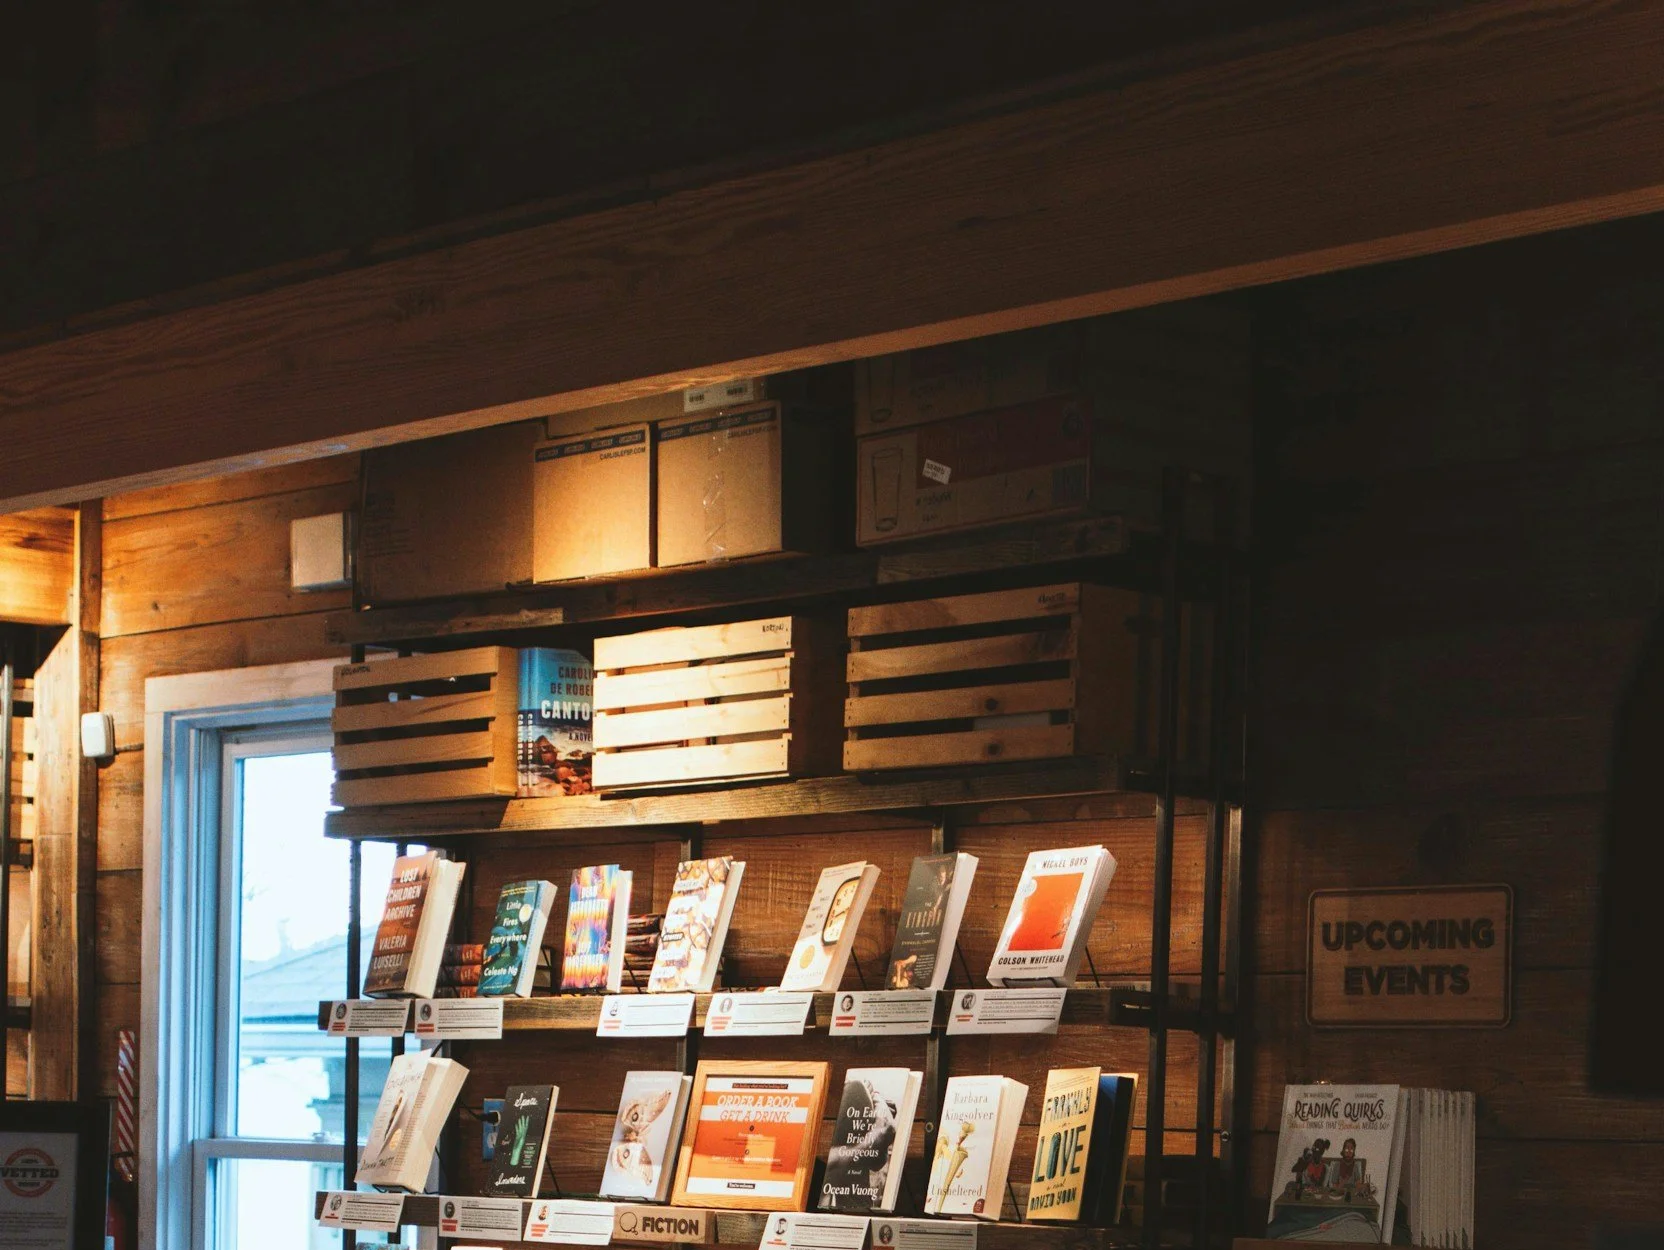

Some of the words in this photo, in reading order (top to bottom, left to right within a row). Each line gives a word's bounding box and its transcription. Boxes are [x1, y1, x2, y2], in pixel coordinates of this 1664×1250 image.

[550, 683, 562, 694] DE
[541, 699, 591, 721] CANTO
[1042, 859, 1066, 869] NICKEL
[1070, 856, 1089, 868] BOYS
[400, 867, 419, 883] LOST
[387, 884, 422, 903] CHILDREN
[385, 903, 416, 921] ARCHIVE
[506, 900, 522, 911] Little
[503, 918, 519, 927] Fires
[490, 932, 527, 945] Everywhere
[1321, 918, 1495, 951] UPCOMING
[379, 935, 407, 951] VALERIA
[373, 954, 404, 970] LUISELLI
[998, 957, 1026, 966] COLSON
[1030, 954, 1065, 965] WHITEHEAD
[484, 966, 507, 977] Celeste
[507, 965, 519, 977] Ng
[1344, 964, 1471, 996] EVENTS
[717, 1095, 754, 1107] ORDER
[755, 1096, 765, 1107] A
[766, 1096, 799, 1108] BOOK
[953, 1093, 988, 1104] Barbara
[1043, 1087, 1092, 1124] FRANKLY
[720, 1110, 742, 1121] GET
[743, 1111, 752, 1121] A
[753, 1111, 790, 1123] DRINK
[846, 1106, 860, 1118] On
[1294, 1098, 1341, 1121] READING
[1344, 1099, 1384, 1121] QUIRKS
[852, 1119, 877, 1131] We're
[847, 1132, 876, 1149] Briefly
[838, 1148, 879, 1161] Gorgeous
[1034, 1124, 1086, 1183] LOVE
[1, 1168, 59, 1179] VETTED
[823, 1184, 850, 1196] Ocean
[852, 1184, 879, 1200] Vuong
[931, 1185, 982, 1197] Unsheltered
[1030, 1193, 1055, 1211] DAVID
[1057, 1188, 1076, 1208] YOON
[642, 1216, 699, 1235] FICTION
